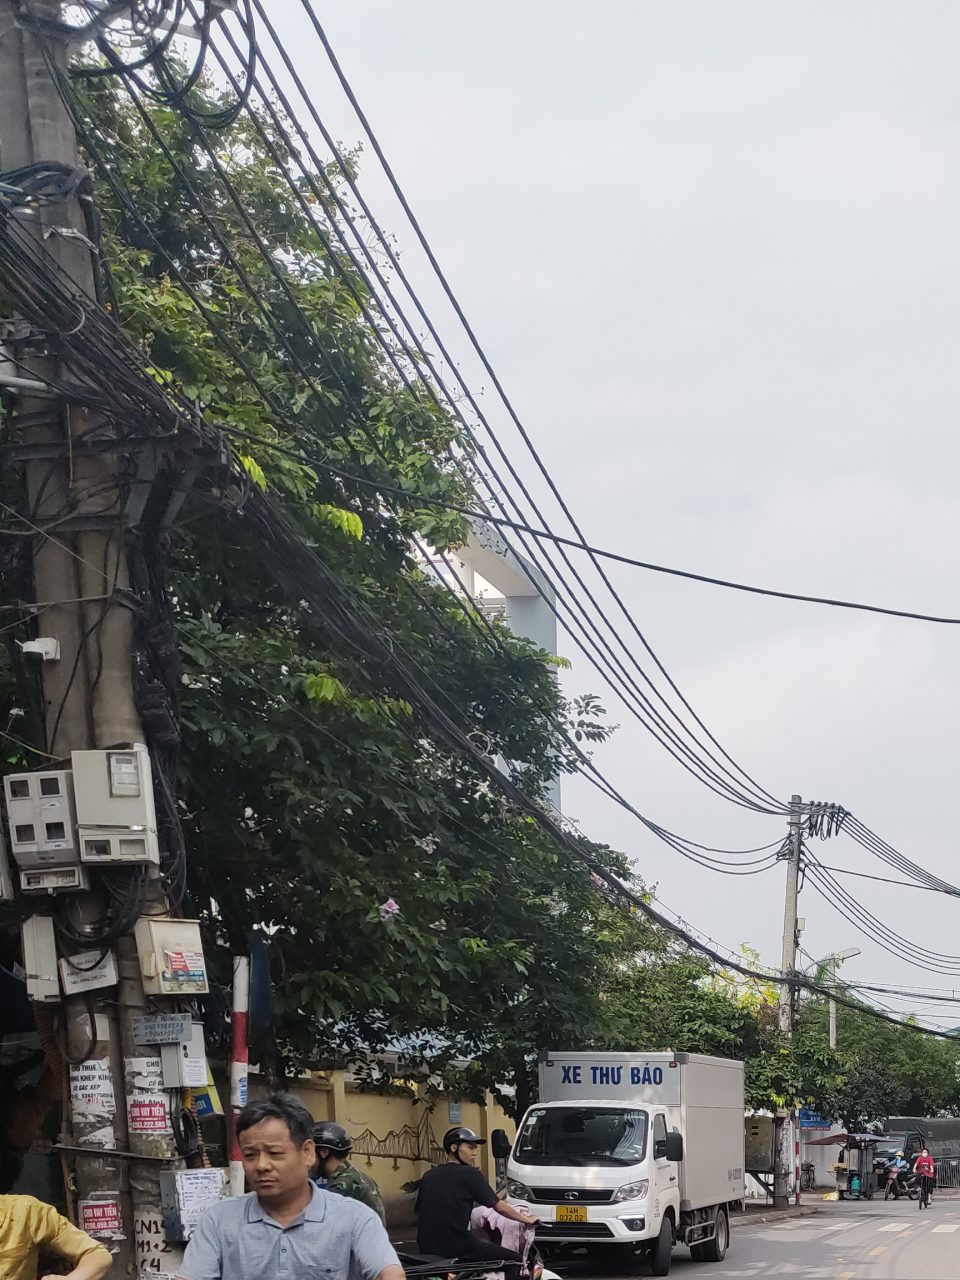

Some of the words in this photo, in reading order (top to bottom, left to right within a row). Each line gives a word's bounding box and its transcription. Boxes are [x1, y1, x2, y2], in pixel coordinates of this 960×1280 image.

[561, 1066, 582, 1084] XE
[590, 1065, 623, 1085] THƯ
[630, 1062, 663, 1085] BÁO
[93, 1207, 103, 1218] VAY
